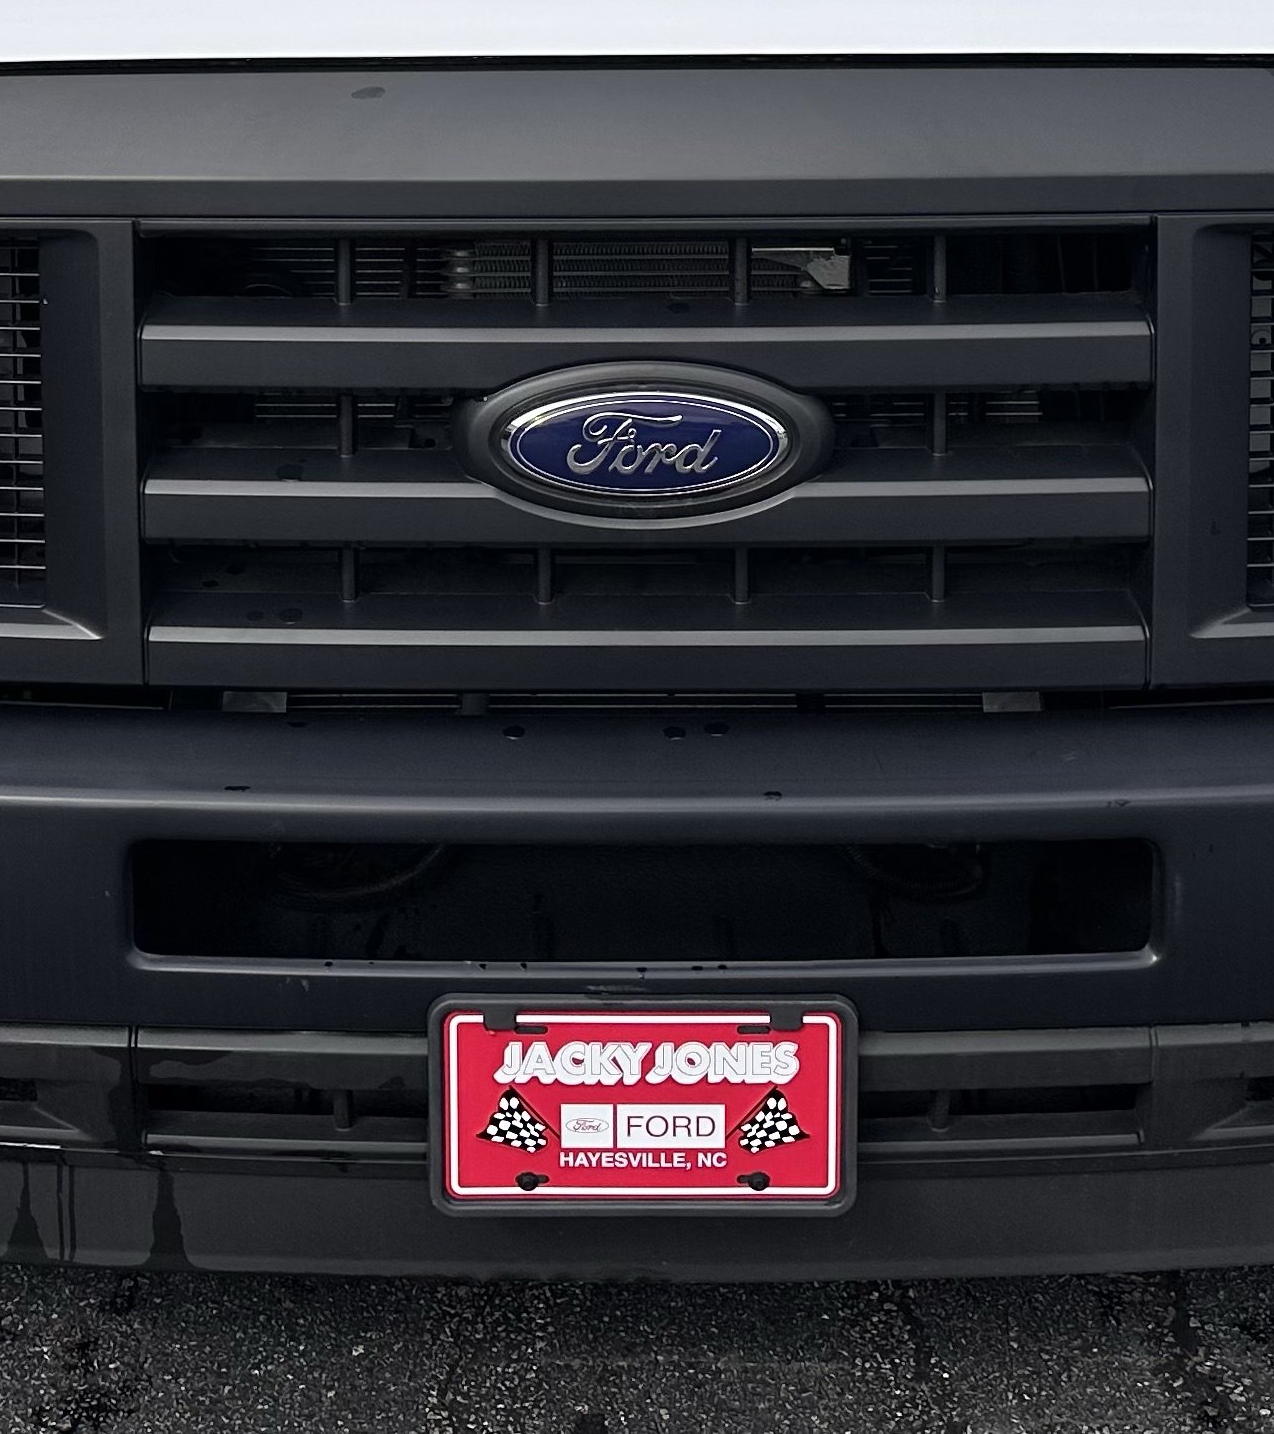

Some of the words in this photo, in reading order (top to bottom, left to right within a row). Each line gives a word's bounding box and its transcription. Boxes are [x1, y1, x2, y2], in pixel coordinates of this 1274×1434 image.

[566, 411, 722, 475] Ford
[493, 1041, 653, 1085] JACKY
[645, 1041, 800, 1085] JONES
[572, 1119, 601, 1133] Ford
[626, 1115, 716, 1138] FORD
[558, 1151, 692, 1170] HAYESVILLE,
[697, 1151, 727, 1168] NC
